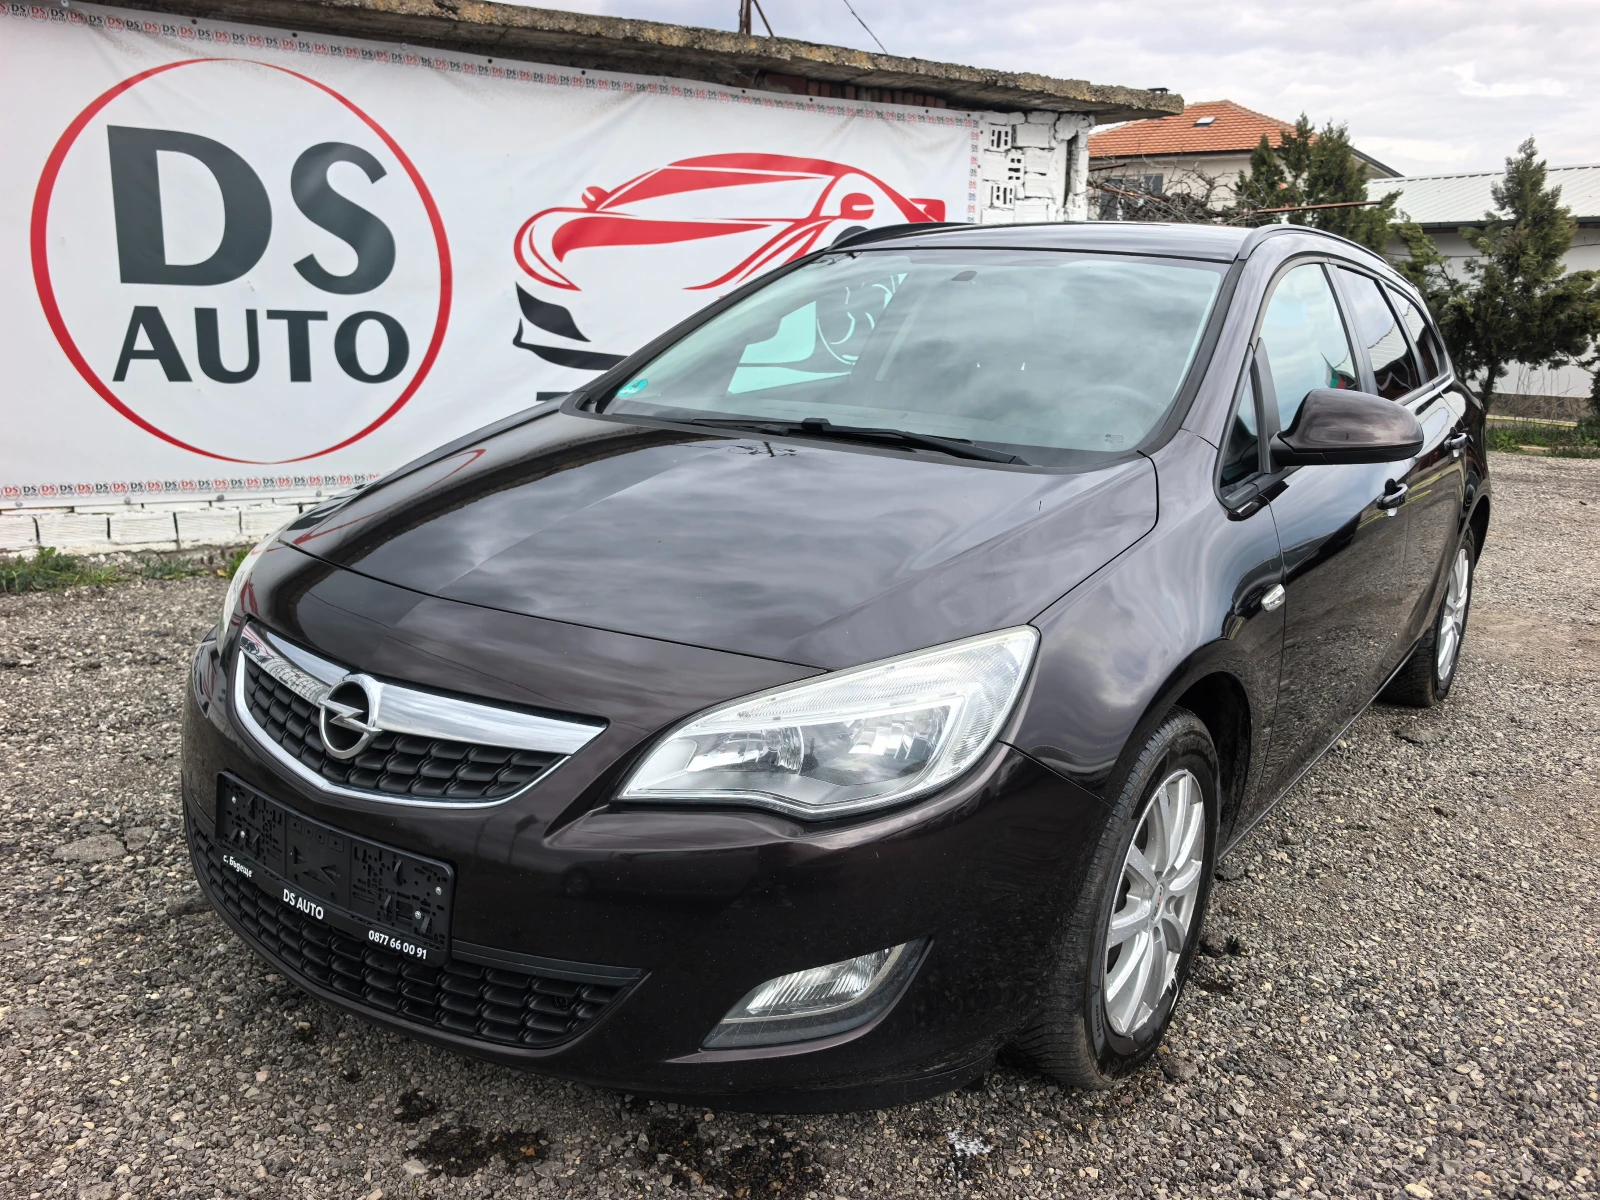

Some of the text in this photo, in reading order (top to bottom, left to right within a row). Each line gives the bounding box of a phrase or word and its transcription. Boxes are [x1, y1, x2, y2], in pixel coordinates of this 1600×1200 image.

[12, 4, 25, 12] DS
[31, 6, 45, 14] DS
[70, 12, 84, 20] DS
[89, 15, 102, 23] DS
[108, 17, 121, 25] DS
[126, 20, 139, 28] DS
[145, 22, 157, 31] DS
[162, 25, 175, 33] DS
[181, 27, 193, 35] DS
[198, 29, 210, 38] DS
[282, 40, 294, 48] DS
[106, 124, 396, 295] DS
[112, 305, 410, 384] AUTO
[282, 888, 324, 920] DS AUTO
[368, 930, 427, 960] 0877 66 00 91
